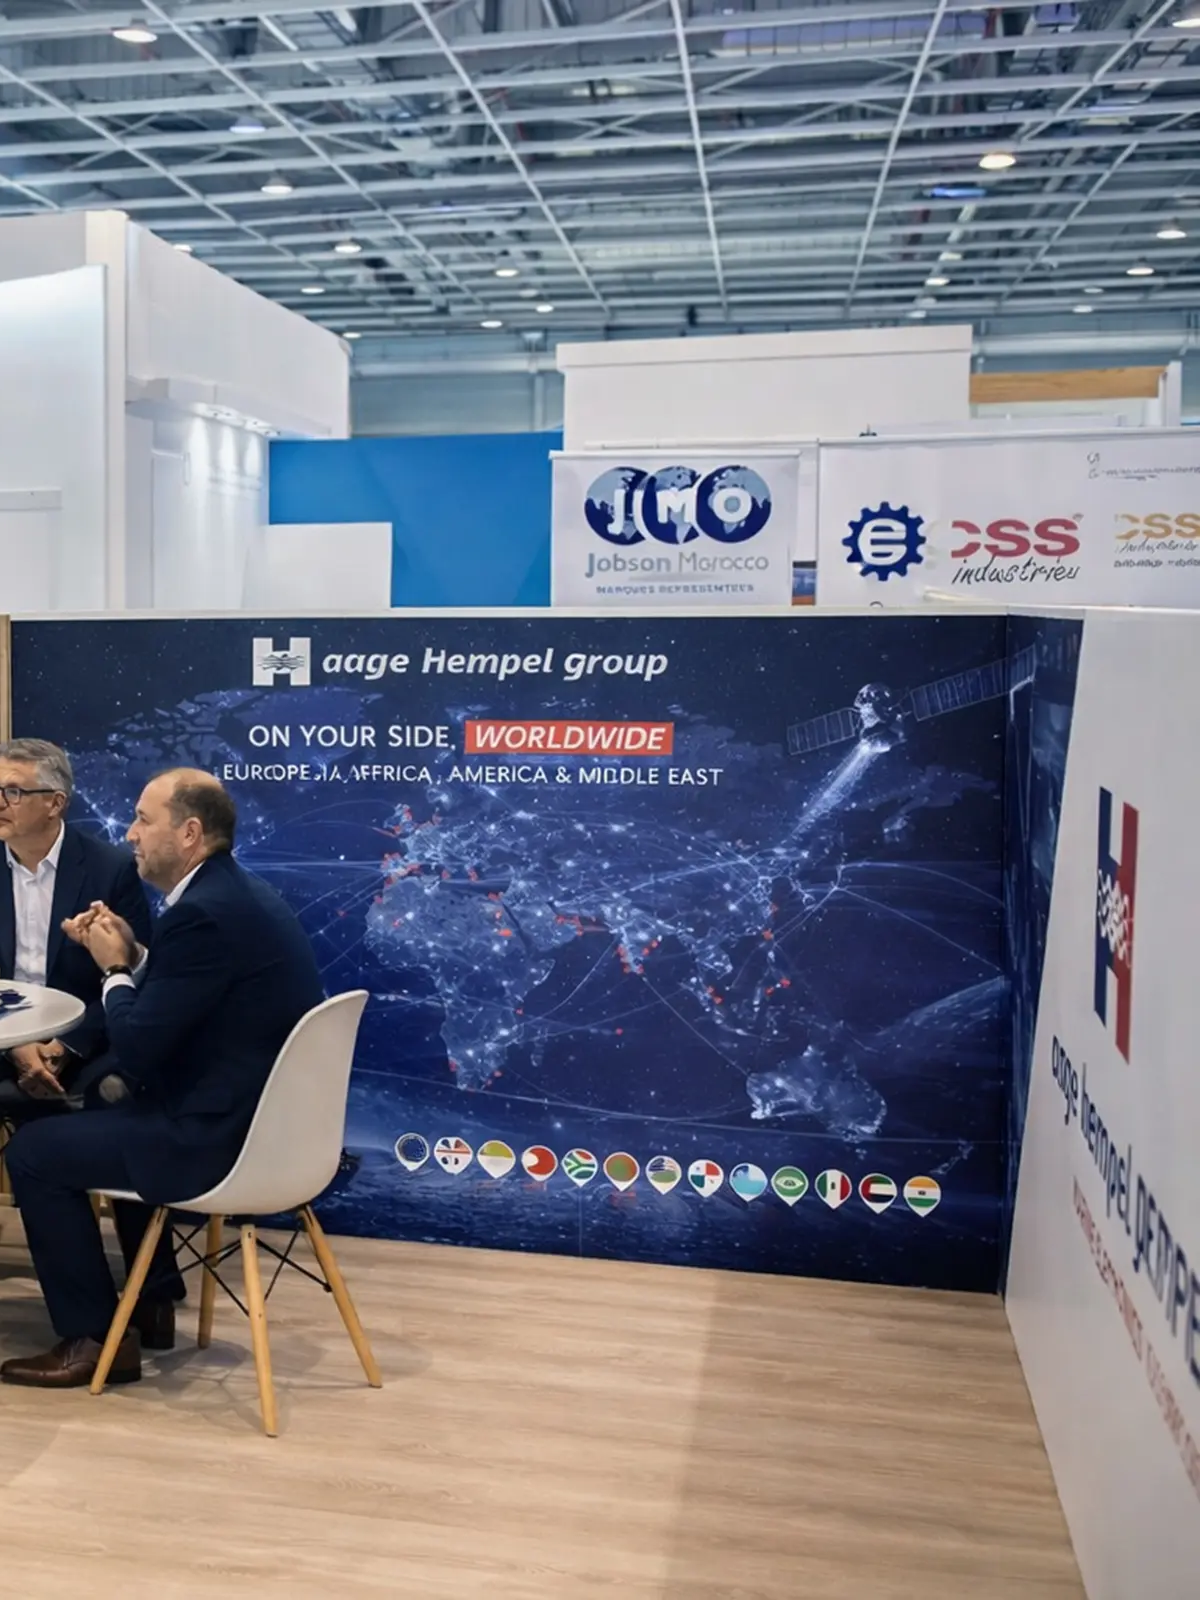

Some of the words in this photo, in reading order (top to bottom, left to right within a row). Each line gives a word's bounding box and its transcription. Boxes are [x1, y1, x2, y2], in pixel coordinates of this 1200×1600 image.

[585, 552, 671, 579] Jobson
[678, 551, 769, 573] Morocco
[322, 651, 409, 681] aage
[422, 648, 553, 682] Hempel
[564, 652, 668, 683] group
[249, 725, 290, 748] ON
[300, 725, 375, 748] YOUR
[475, 724, 666, 750] WORLDWIDE
[448, 765, 548, 785] AMERICA
[556, 766, 572, 785] &
[668, 767, 723, 786] EAST
